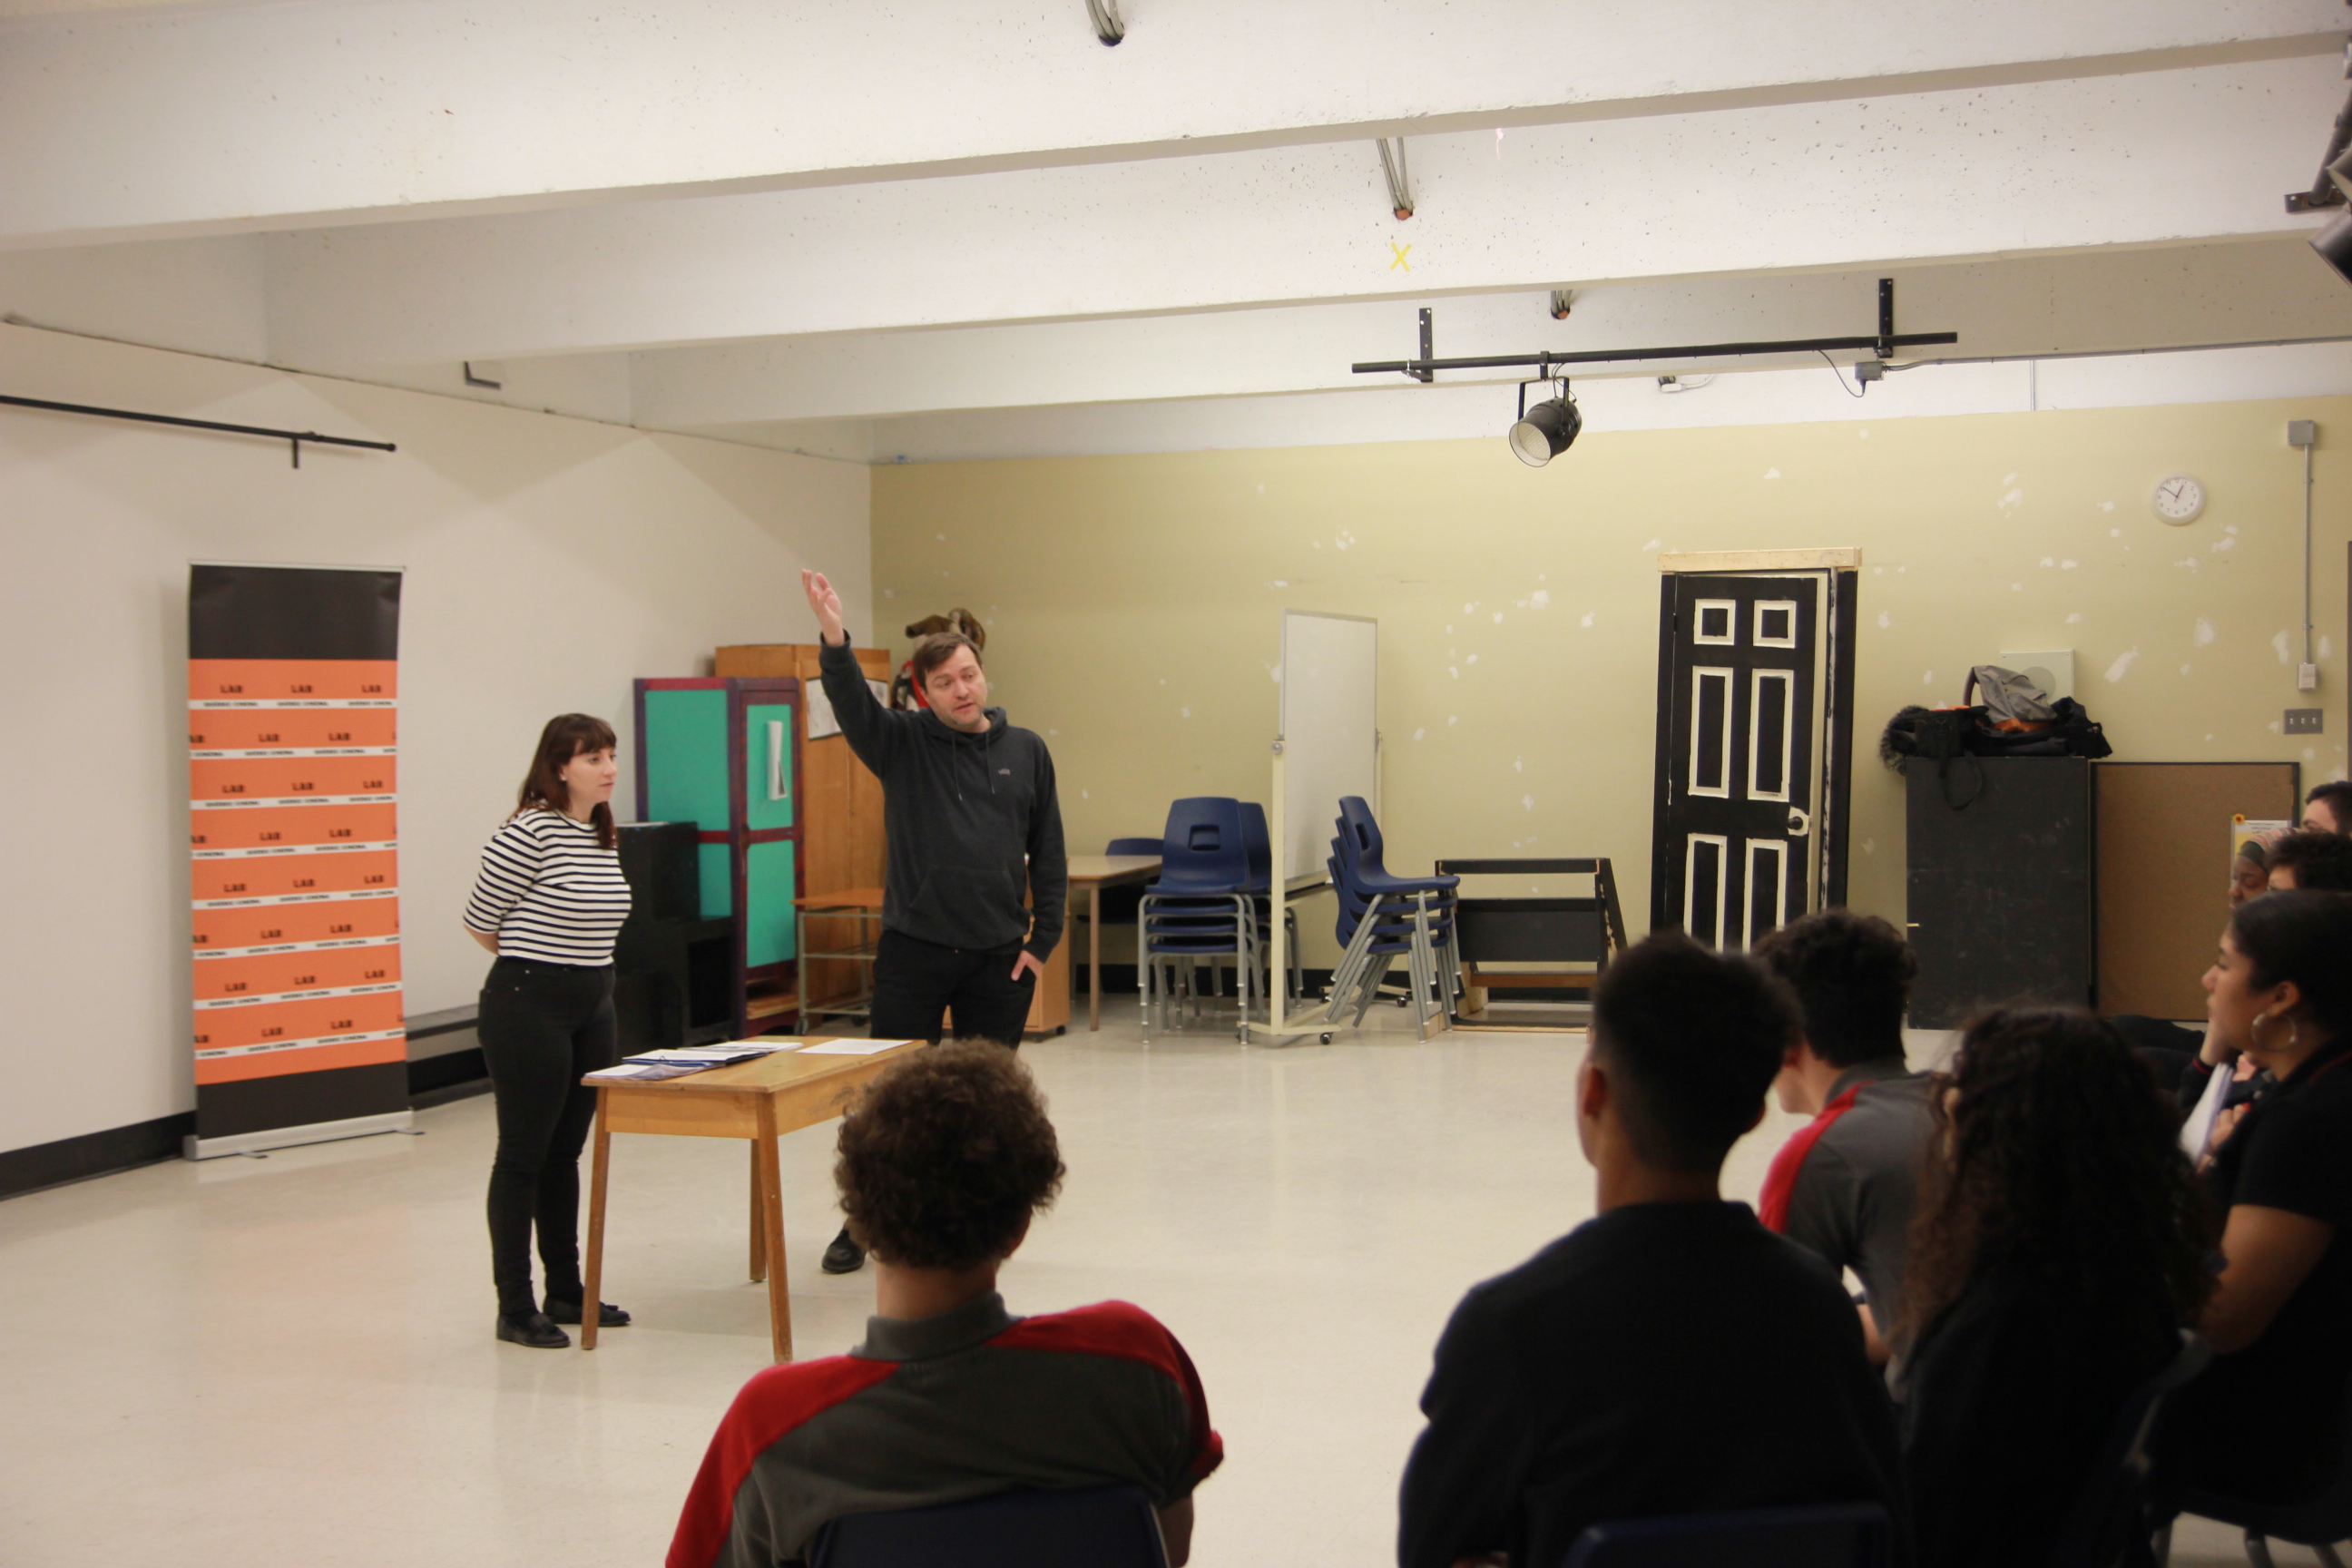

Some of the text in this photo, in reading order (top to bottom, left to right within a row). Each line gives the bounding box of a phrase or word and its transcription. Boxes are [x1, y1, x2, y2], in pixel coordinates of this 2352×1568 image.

[220, 685, 243, 693] LAB
[291, 685, 312, 693] LAB
[189, 735, 204, 743] AB
[259, 733, 279, 742] LAB
[328, 732, 350, 741] LAB
[221, 785, 244, 793] LAB
[292, 782, 313, 790] LAB
[364, 780, 382, 789] LAB
[260, 832, 280, 841] LAB
[329, 828, 351, 838] LAB
[191, 836, 206, 844] AB
[294, 878, 314, 887] LAB
[364, 875, 384, 884] LAB
[223, 883, 246, 892] LAB
[330, 924, 352, 934] LAB
[261, 929, 281, 939] LAB
[192, 935, 208, 943] AB
[365, 970, 385, 979] LAB
[294, 975, 316, 985] LAB
[225, 983, 247, 992] LAB
[331, 1020, 352, 1030] LAB
[261, 1027, 282, 1037] LAB
[194, 1034, 210, 1044] AB
